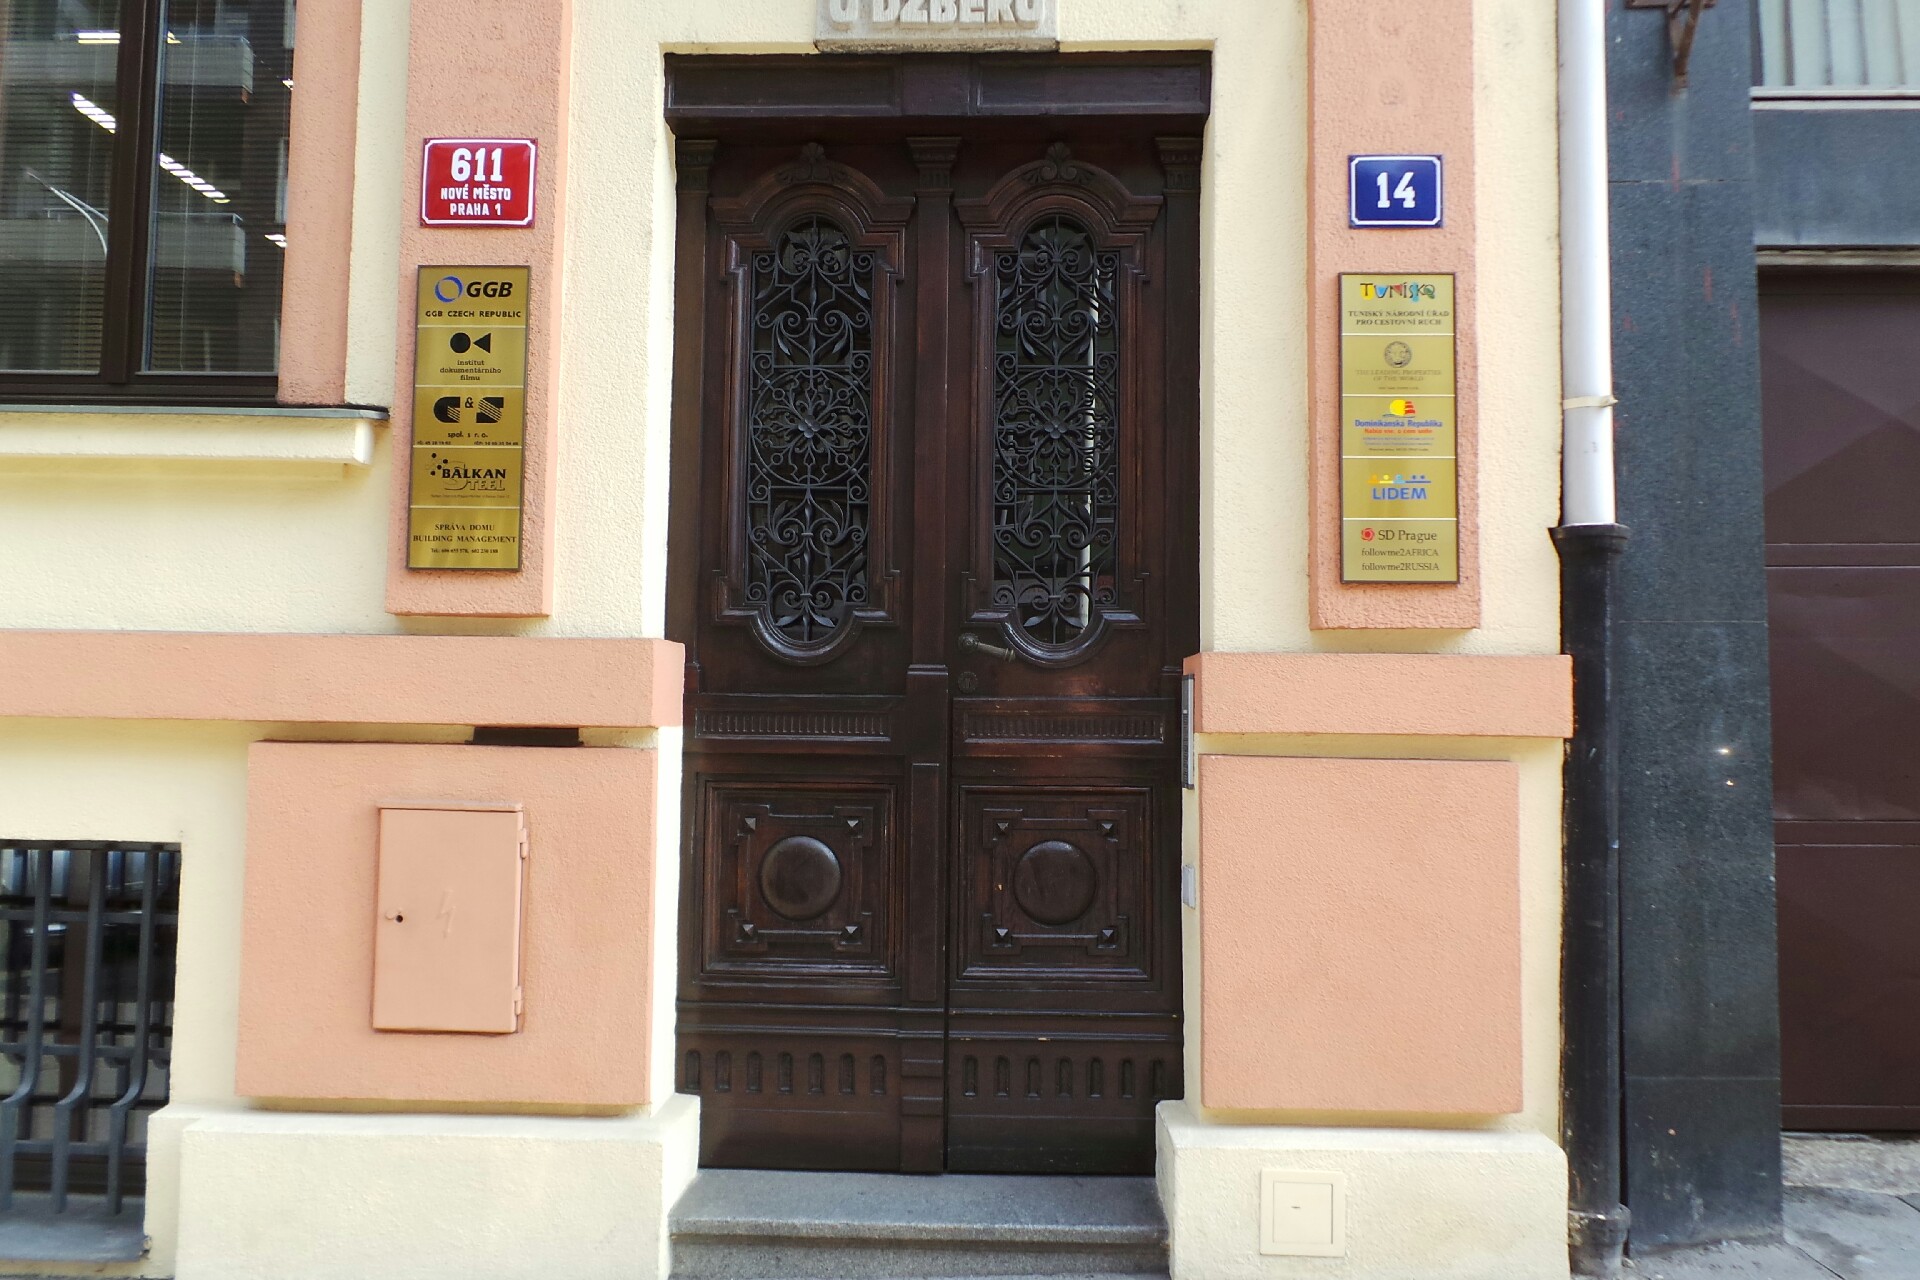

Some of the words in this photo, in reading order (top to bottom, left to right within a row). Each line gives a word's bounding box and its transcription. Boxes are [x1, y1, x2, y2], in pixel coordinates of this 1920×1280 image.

[451, 148, 503, 182] 611
[440, 184, 468, 200] NOVÉ
[473, 184, 511, 201] MĚSTO
[1377, 172, 1416, 209] 14
[450, 203, 489, 216] PRAHA
[495, 203, 502, 216] 1
[466, 281, 513, 298] GGB
[442, 468, 506, 479] BALKAN
[1372, 487, 1427, 500] LIDEM
[457, 535, 517, 543] MANAGEMENT
[1378, 530, 1395, 540] SD
[1398, 530, 1437, 543] Prague
[1361, 548, 1439, 556] followme2AFRICA
[1361, 563, 1440, 571] followme2RUSSIA
